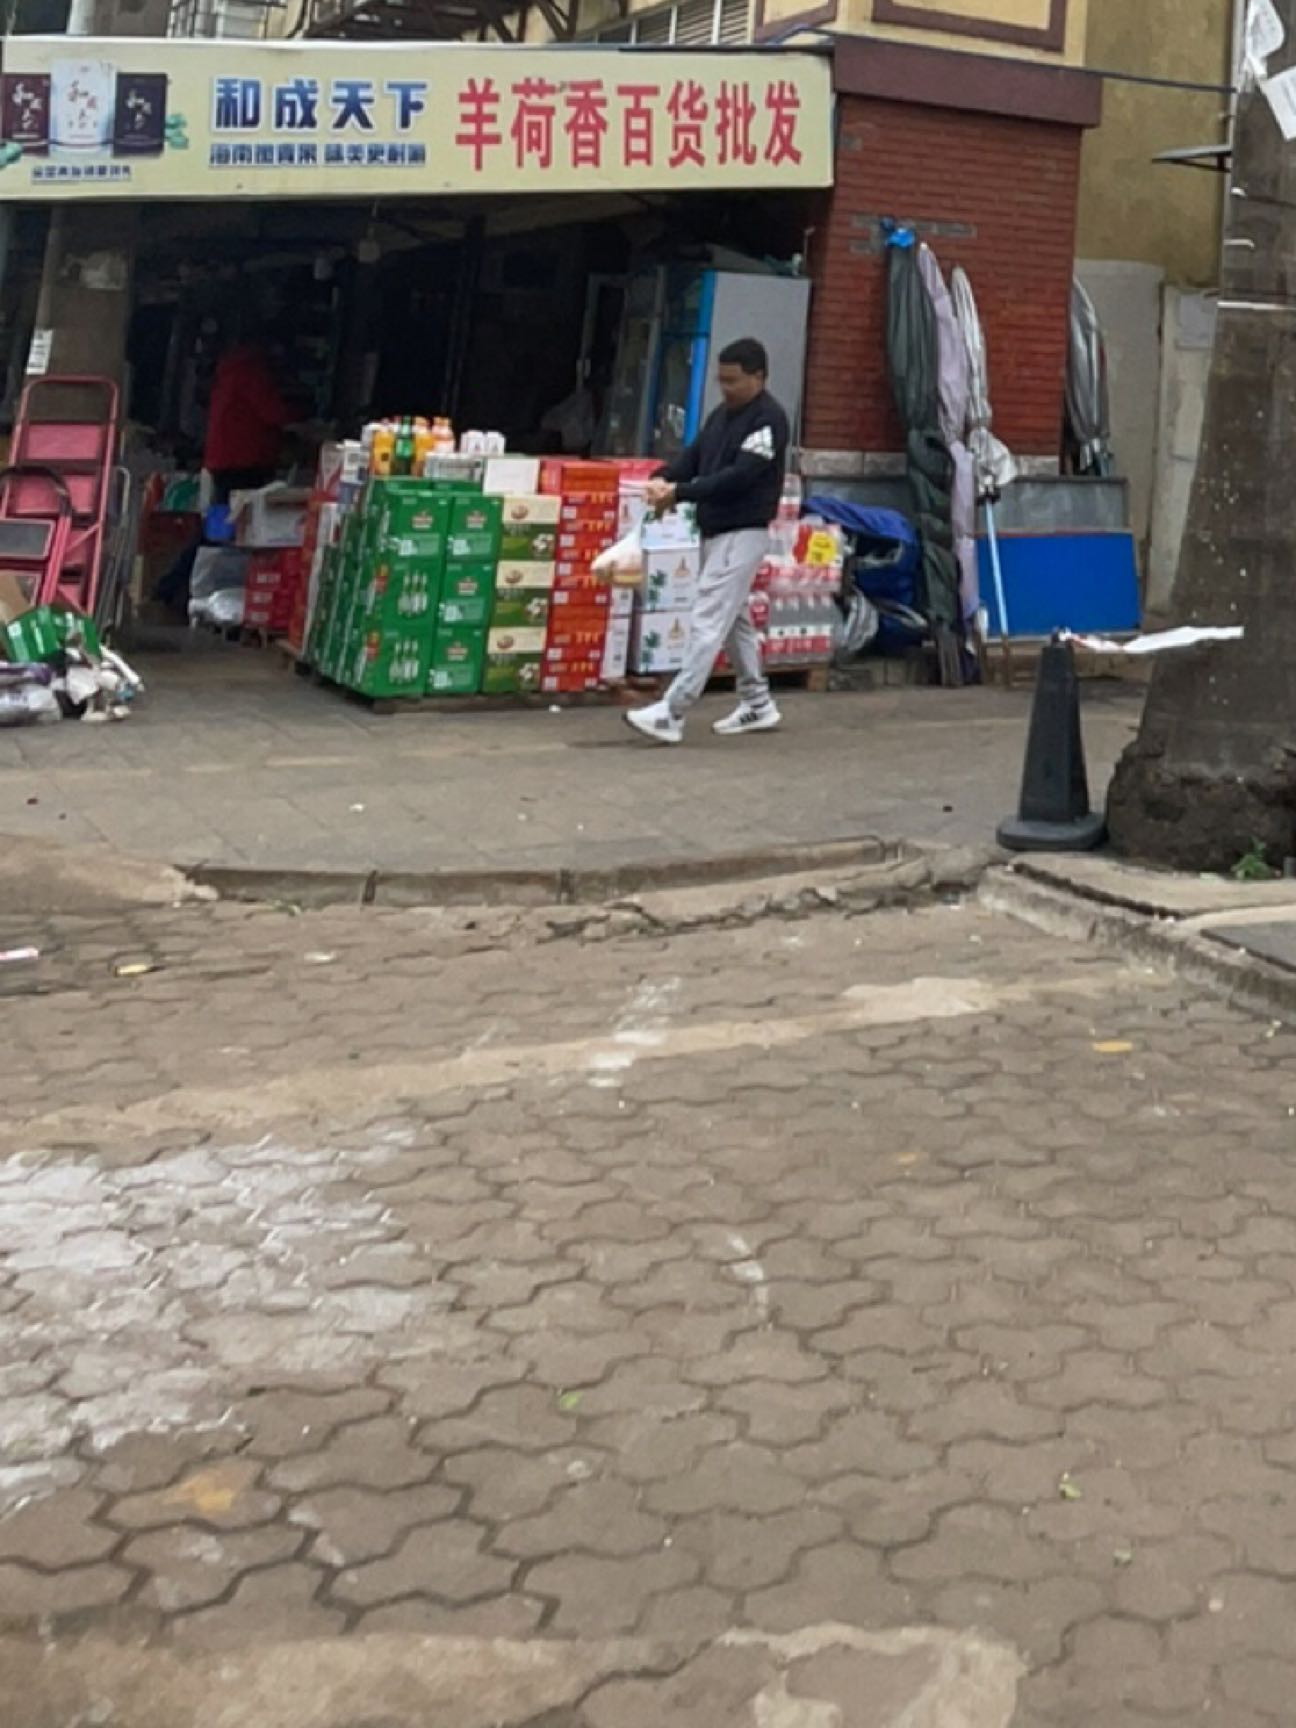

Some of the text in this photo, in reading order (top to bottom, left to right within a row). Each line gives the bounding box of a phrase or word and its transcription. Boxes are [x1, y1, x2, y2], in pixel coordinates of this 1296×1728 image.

[214, 77, 428, 130] 和成天下
[455, 78, 802, 172] 羊荷香百货批发
